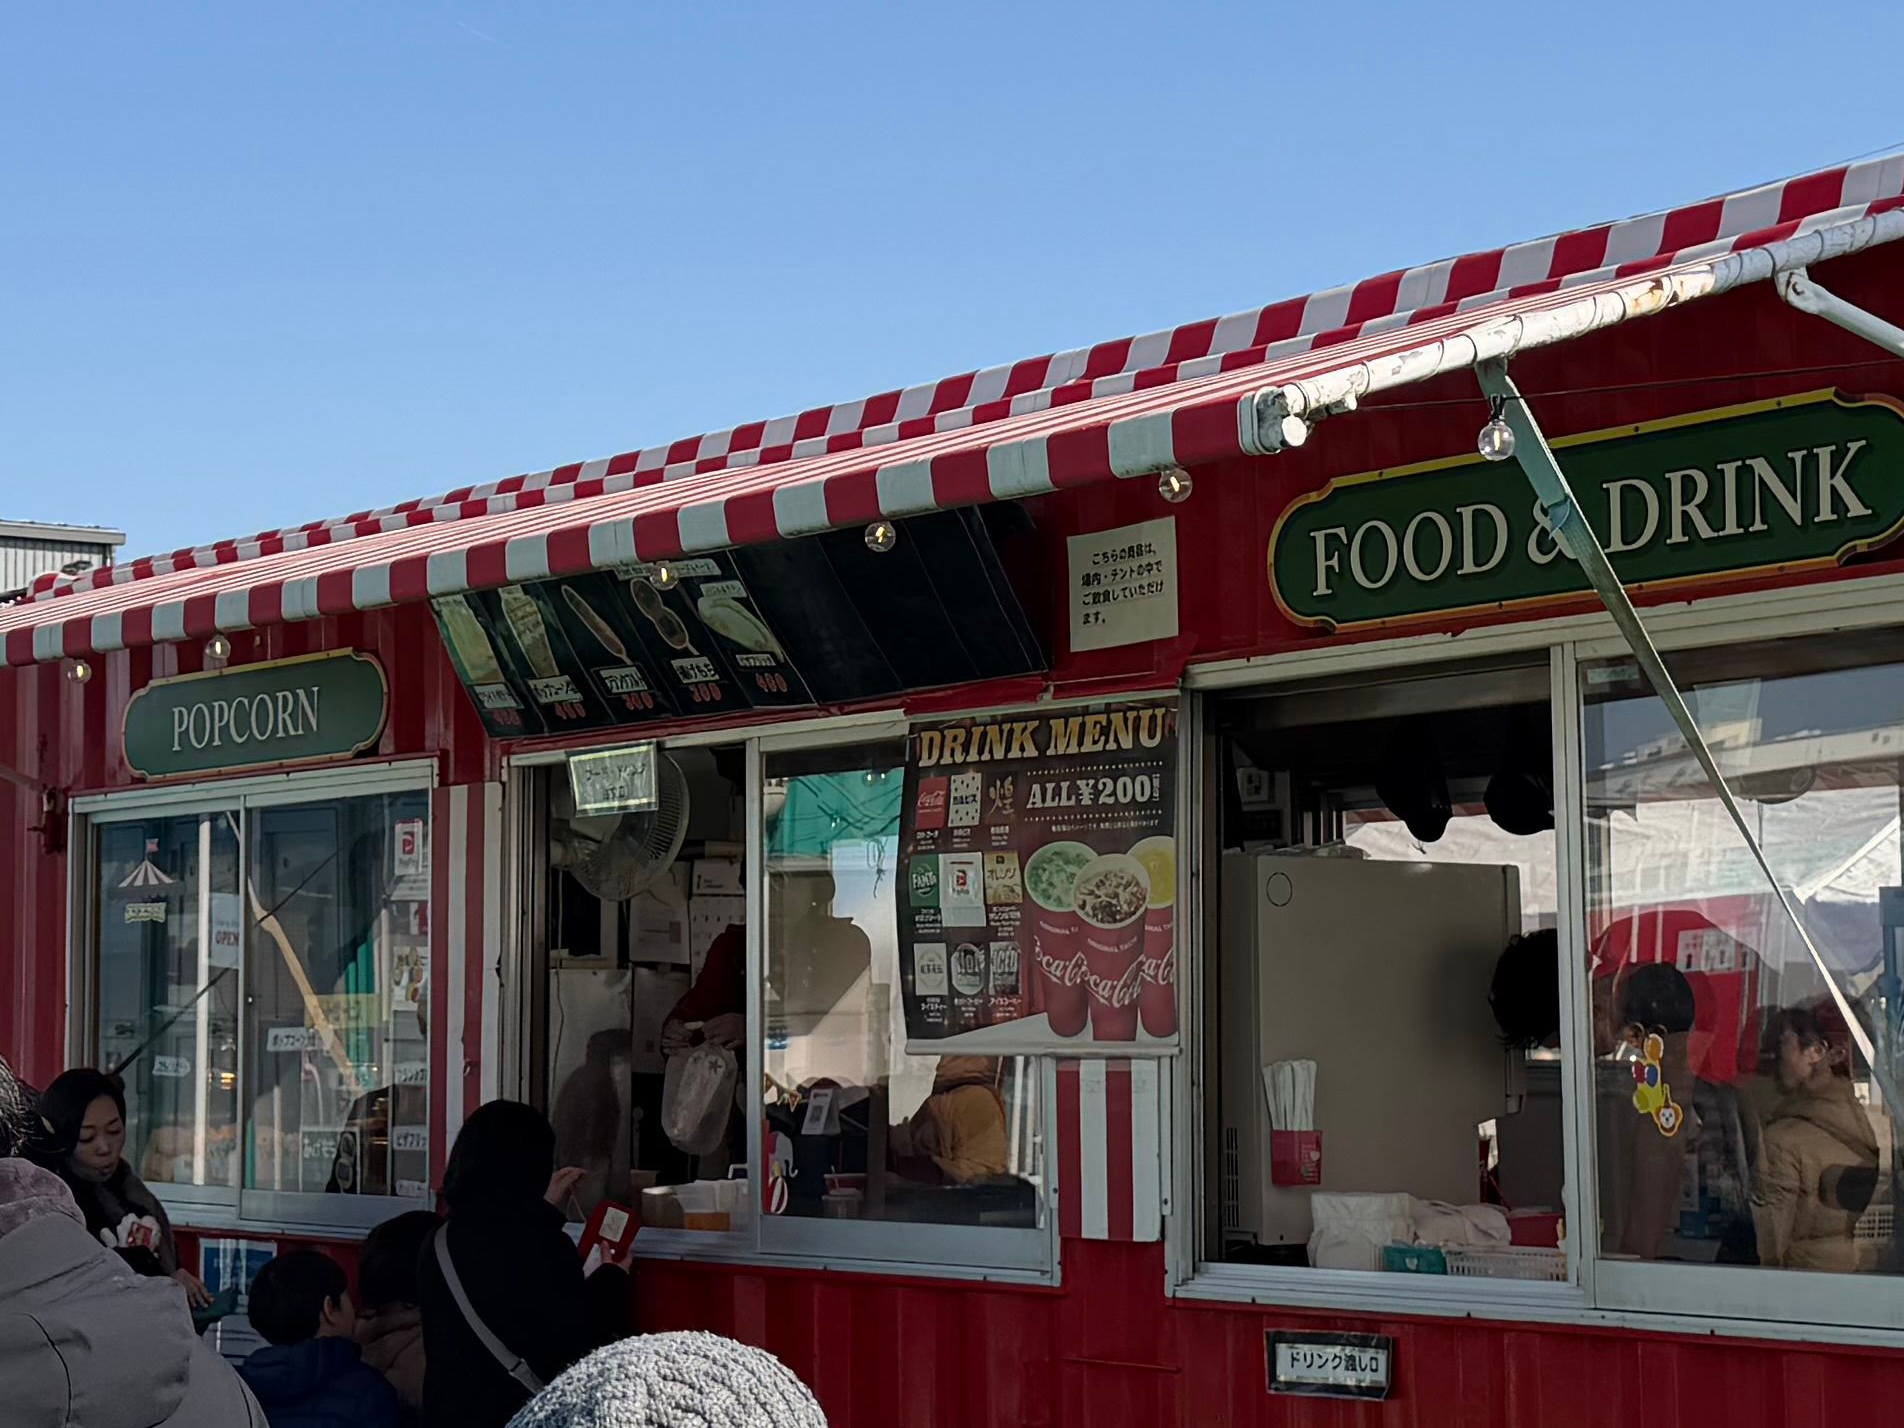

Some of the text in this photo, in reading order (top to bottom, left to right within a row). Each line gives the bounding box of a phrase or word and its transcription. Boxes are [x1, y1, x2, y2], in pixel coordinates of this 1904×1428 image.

[1309, 439, 1872, 597] FOOD & DRINK
[1082, 580, 1164, 606] ご飲食していただけ
[1083, 611, 1106, 625] ます。
[172, 687, 320, 751] POPCORN
[919, 708, 1166, 767] DRINK MENU
[215, 930, 239, 946] OPEN
[1291, 1351, 1379, 1373] ドリンク渡し口
